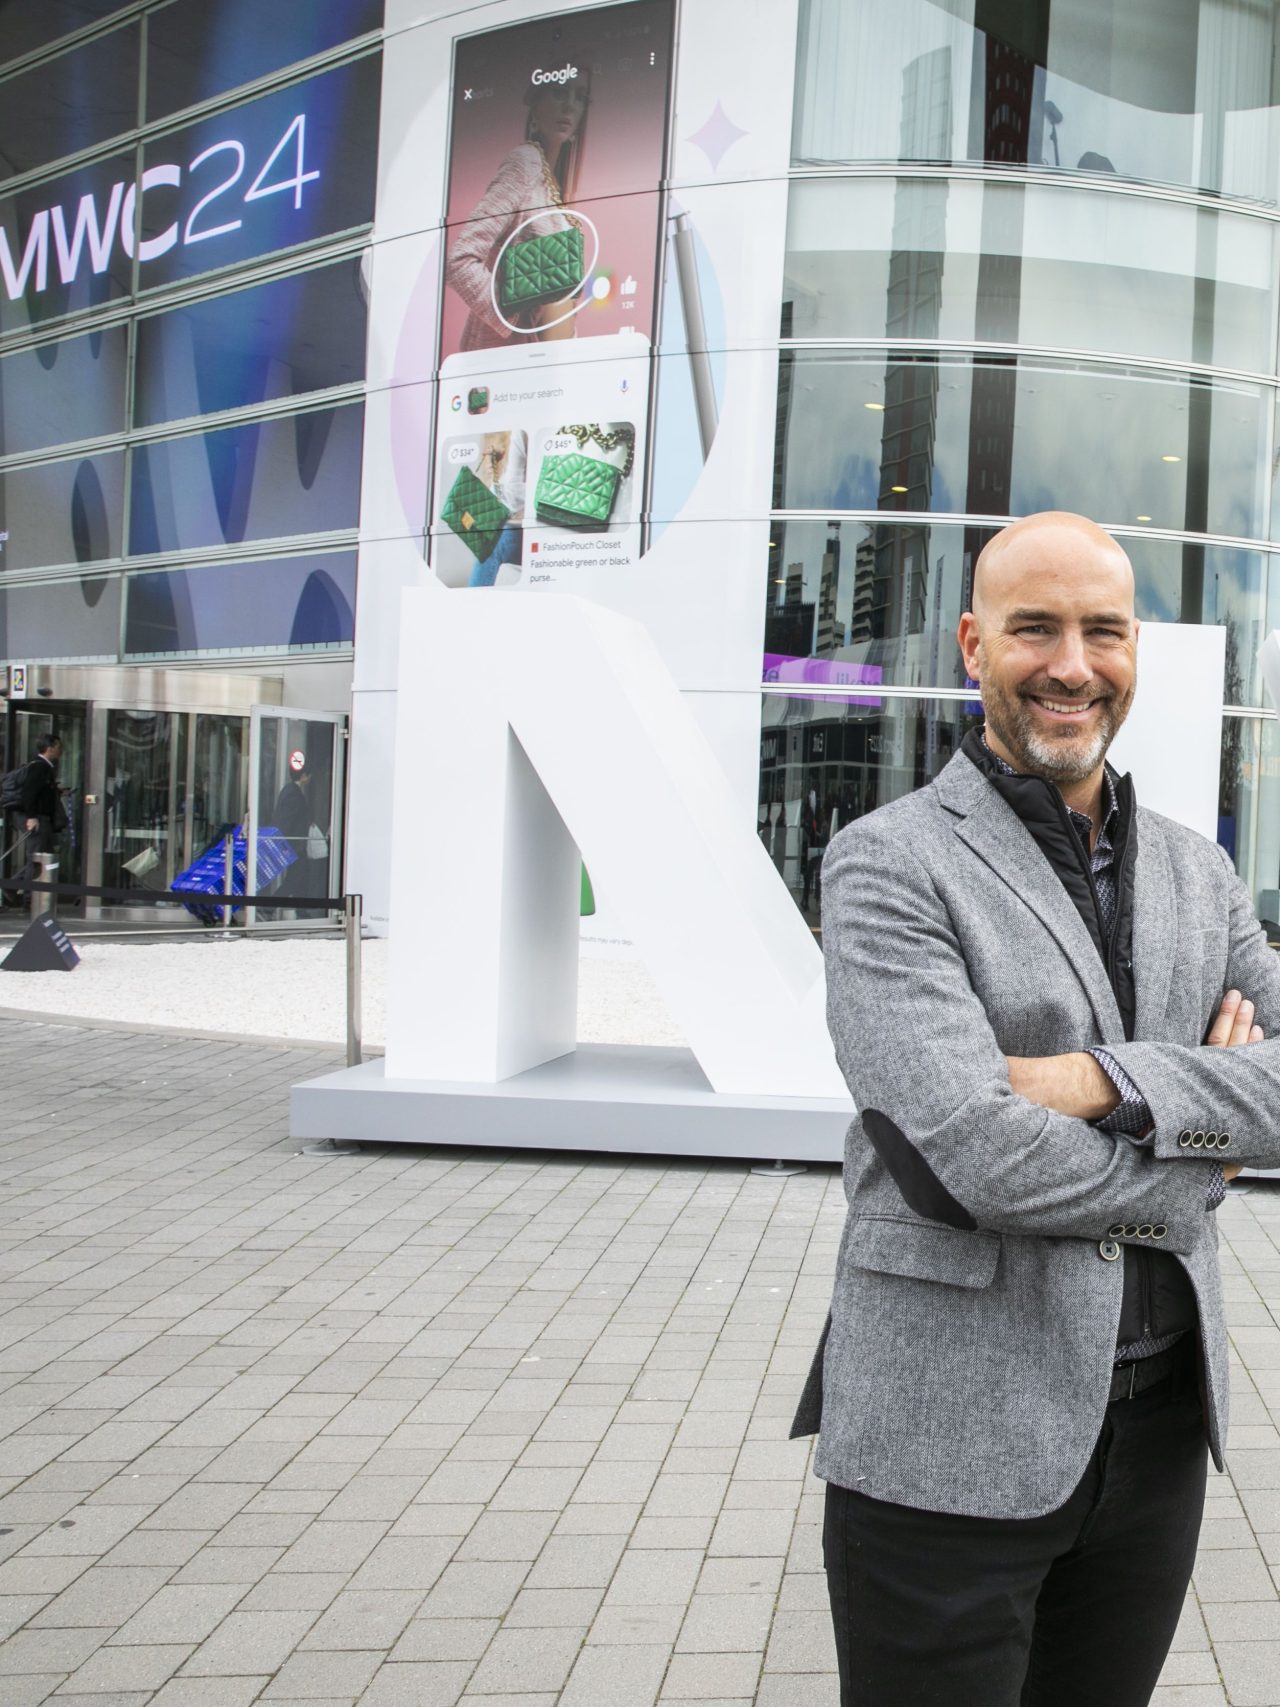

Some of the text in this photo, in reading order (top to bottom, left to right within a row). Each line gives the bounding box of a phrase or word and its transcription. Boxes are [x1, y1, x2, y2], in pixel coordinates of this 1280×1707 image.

[531, 63, 578, 85] Google
[0, 114, 320, 300] MWC24
[494, 387, 564, 402] Add to your search
[543, 540, 622, 551] FashionPouch Closet
[530, 559, 574, 568] Fashionable
[575, 559, 597, 568] green
[609, 557, 631, 566] black
